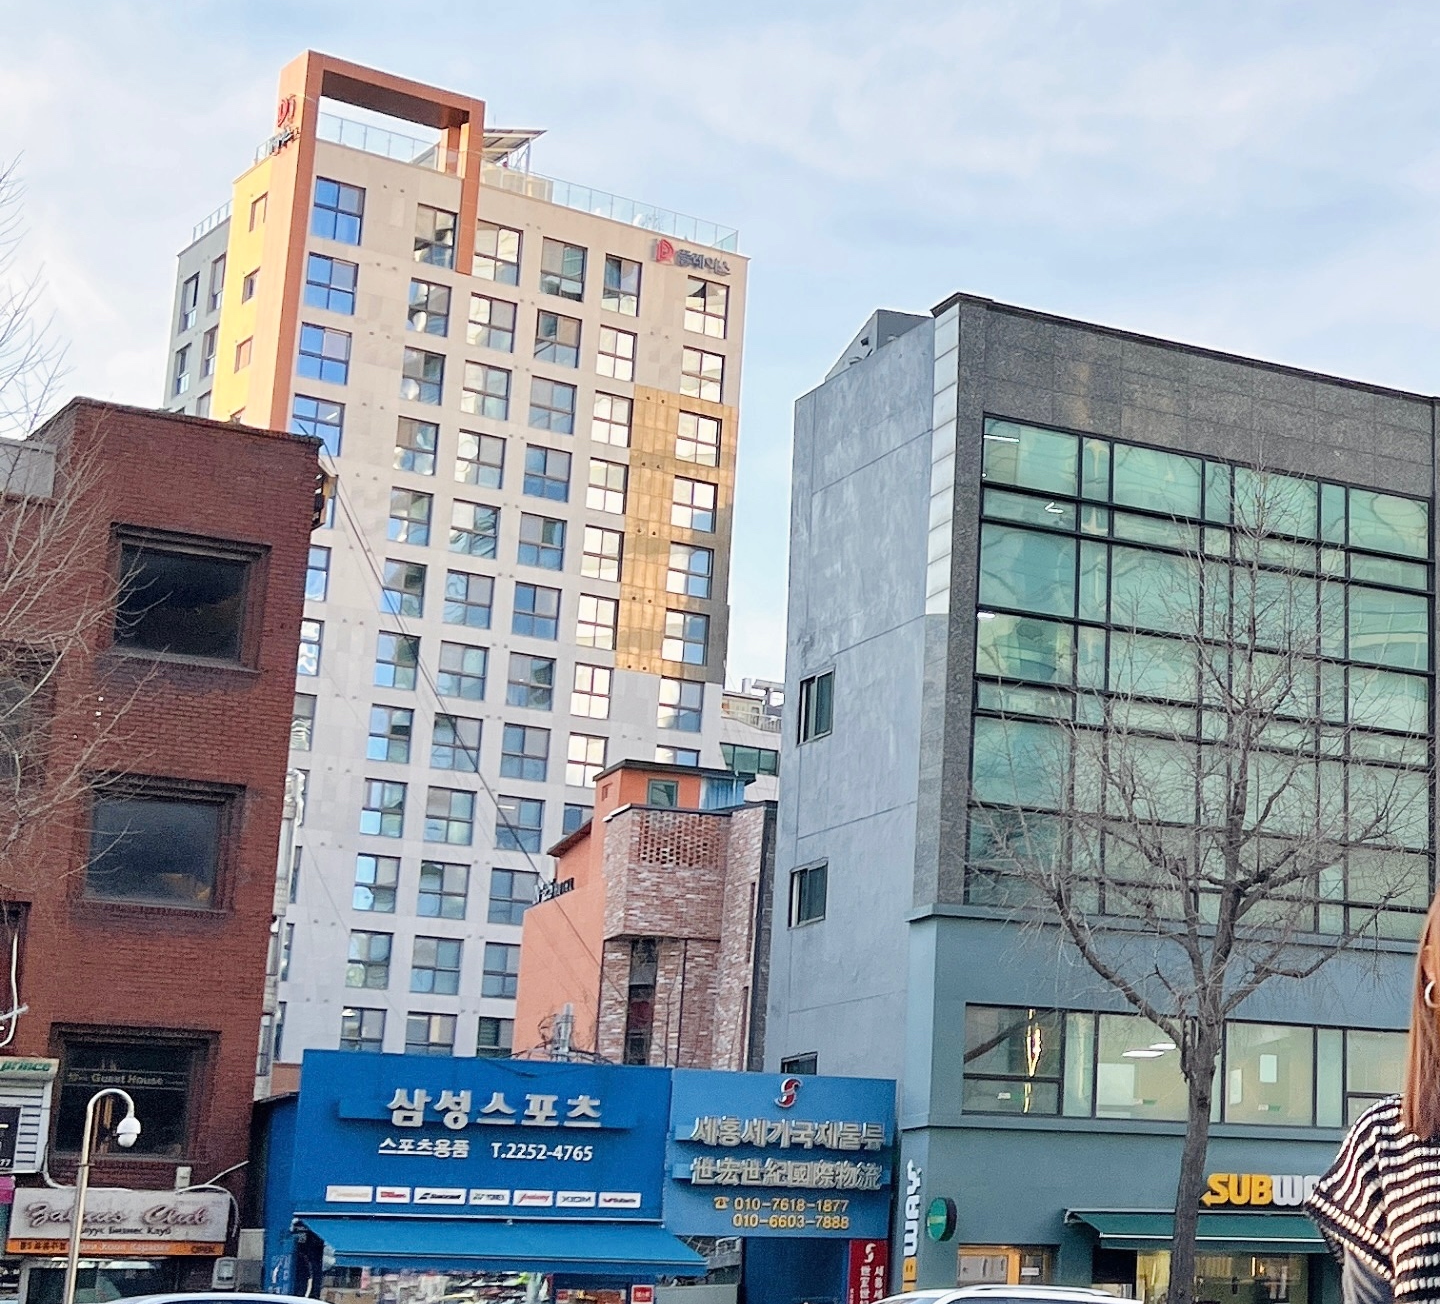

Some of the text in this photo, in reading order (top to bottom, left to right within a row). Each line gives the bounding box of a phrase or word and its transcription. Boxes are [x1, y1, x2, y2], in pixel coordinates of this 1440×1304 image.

[387, 1088, 602, 1130] 삼성스포츠
[378, 1137, 470, 1159] 스포츠용품
[490, 1142, 594, 1162] T.2252-4765
[1200, 1173, 1322, 1206] SUBW
[734, 1197, 850, 1213] 010-7618-1877
[733, 1214, 850, 1230] 010-6603-7888
